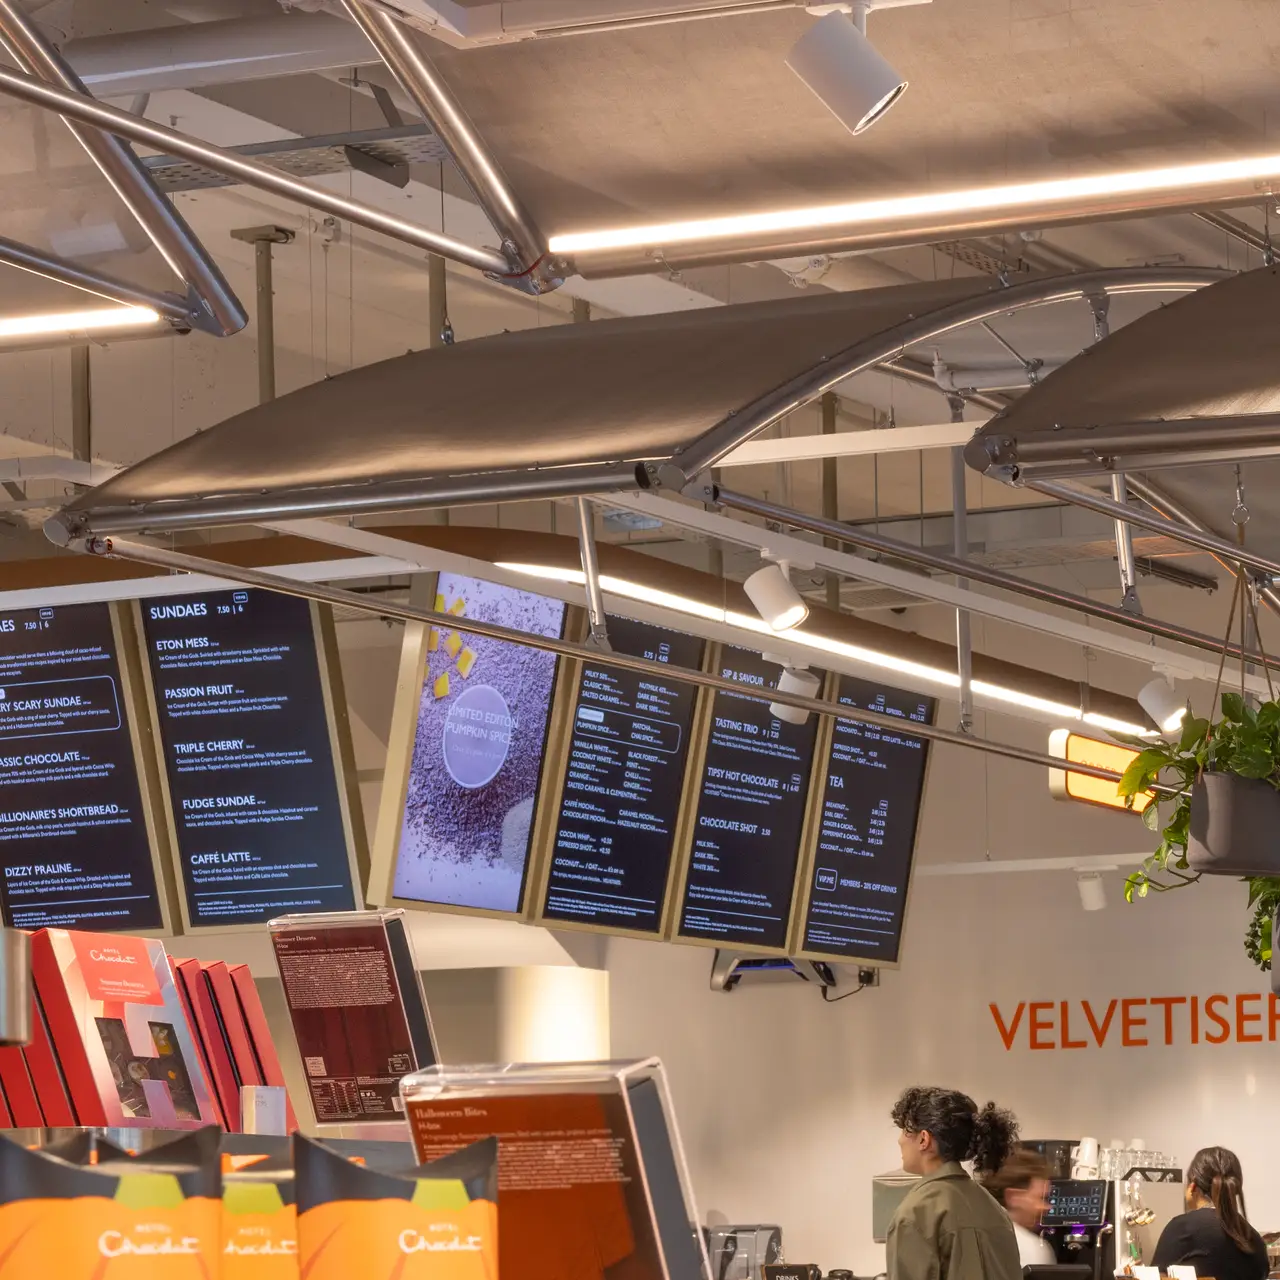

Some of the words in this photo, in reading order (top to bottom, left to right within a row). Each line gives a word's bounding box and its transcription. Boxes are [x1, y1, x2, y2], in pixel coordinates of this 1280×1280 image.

[150, 603, 208, 619] SUNDAES
[217, 606, 230, 614] 7.50
[238, 604, 244, 612] 6
[45, 620, 50, 628] 6
[156, 640, 184, 651] ETON
[185, 638, 209, 648] MESS
[739, 673, 764, 686] SAVOUR
[165, 687, 204, 698] PASSION
[206, 684, 234, 696] FRUIT
[14, 698, 42, 712] SCARY
[44, 696, 82, 709] SUNDAE
[448, 704, 482, 720] LIMITED
[446, 722, 488, 739] PUMPKIN
[715, 717, 741, 732] TASTING
[743, 723, 758, 734] TRIO
[174, 742, 206, 754] TRIPLE
[207, 739, 244, 752] CHERRY
[24, 752, 81, 766] CHOCOLATE
[708, 767, 724, 779] TIPSY
[726, 770, 740, 782] HOT
[741, 773, 779, 788] CHOCOLATE
[830, 776, 843, 788] TEA
[183, 798, 215, 810] FUDGE
[216, 795, 256, 807] SUNDAE
[58, 804, 119, 819] SHORTBREAD
[700, 816, 739, 831] CHOCOLATE
[740, 823, 758, 834] SHOT
[190, 851, 220, 865] CAFFÉ
[222, 852, 251, 863] LATTE
[4, 866, 33, 878] DIZZY
[34, 863, 72, 876] PRALINE
[416, 1108, 462, 1119] Halloween
[464, 1106, 488, 1117] Bites
[418, 1122, 441, 1130] H-box
